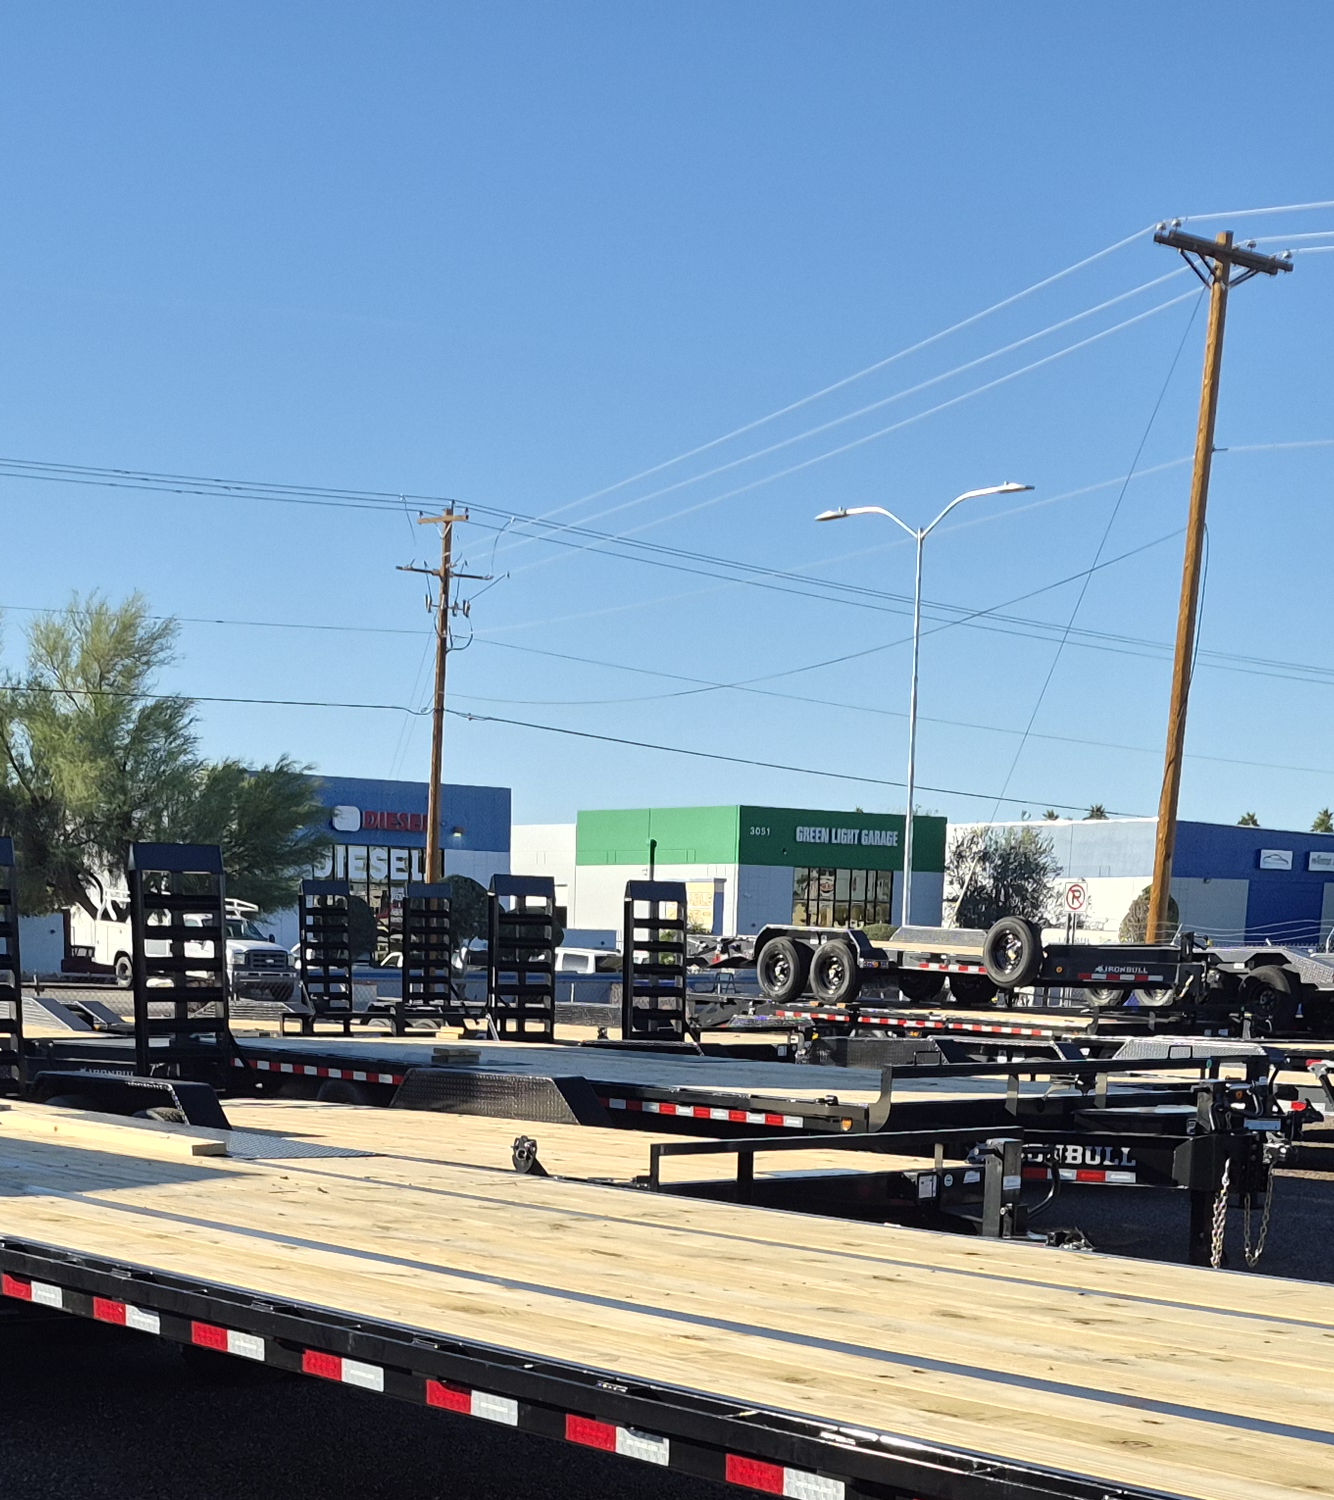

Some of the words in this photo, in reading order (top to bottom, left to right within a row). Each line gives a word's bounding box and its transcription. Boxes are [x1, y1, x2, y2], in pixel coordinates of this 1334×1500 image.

[750, 826, 770, 836] 3051
[796, 826, 829, 844] GREEN
[831, 828, 859, 845] LIGHT
[861, 829, 898, 847] GARAGE
[1105, 966, 1148, 974] IRONBULL
